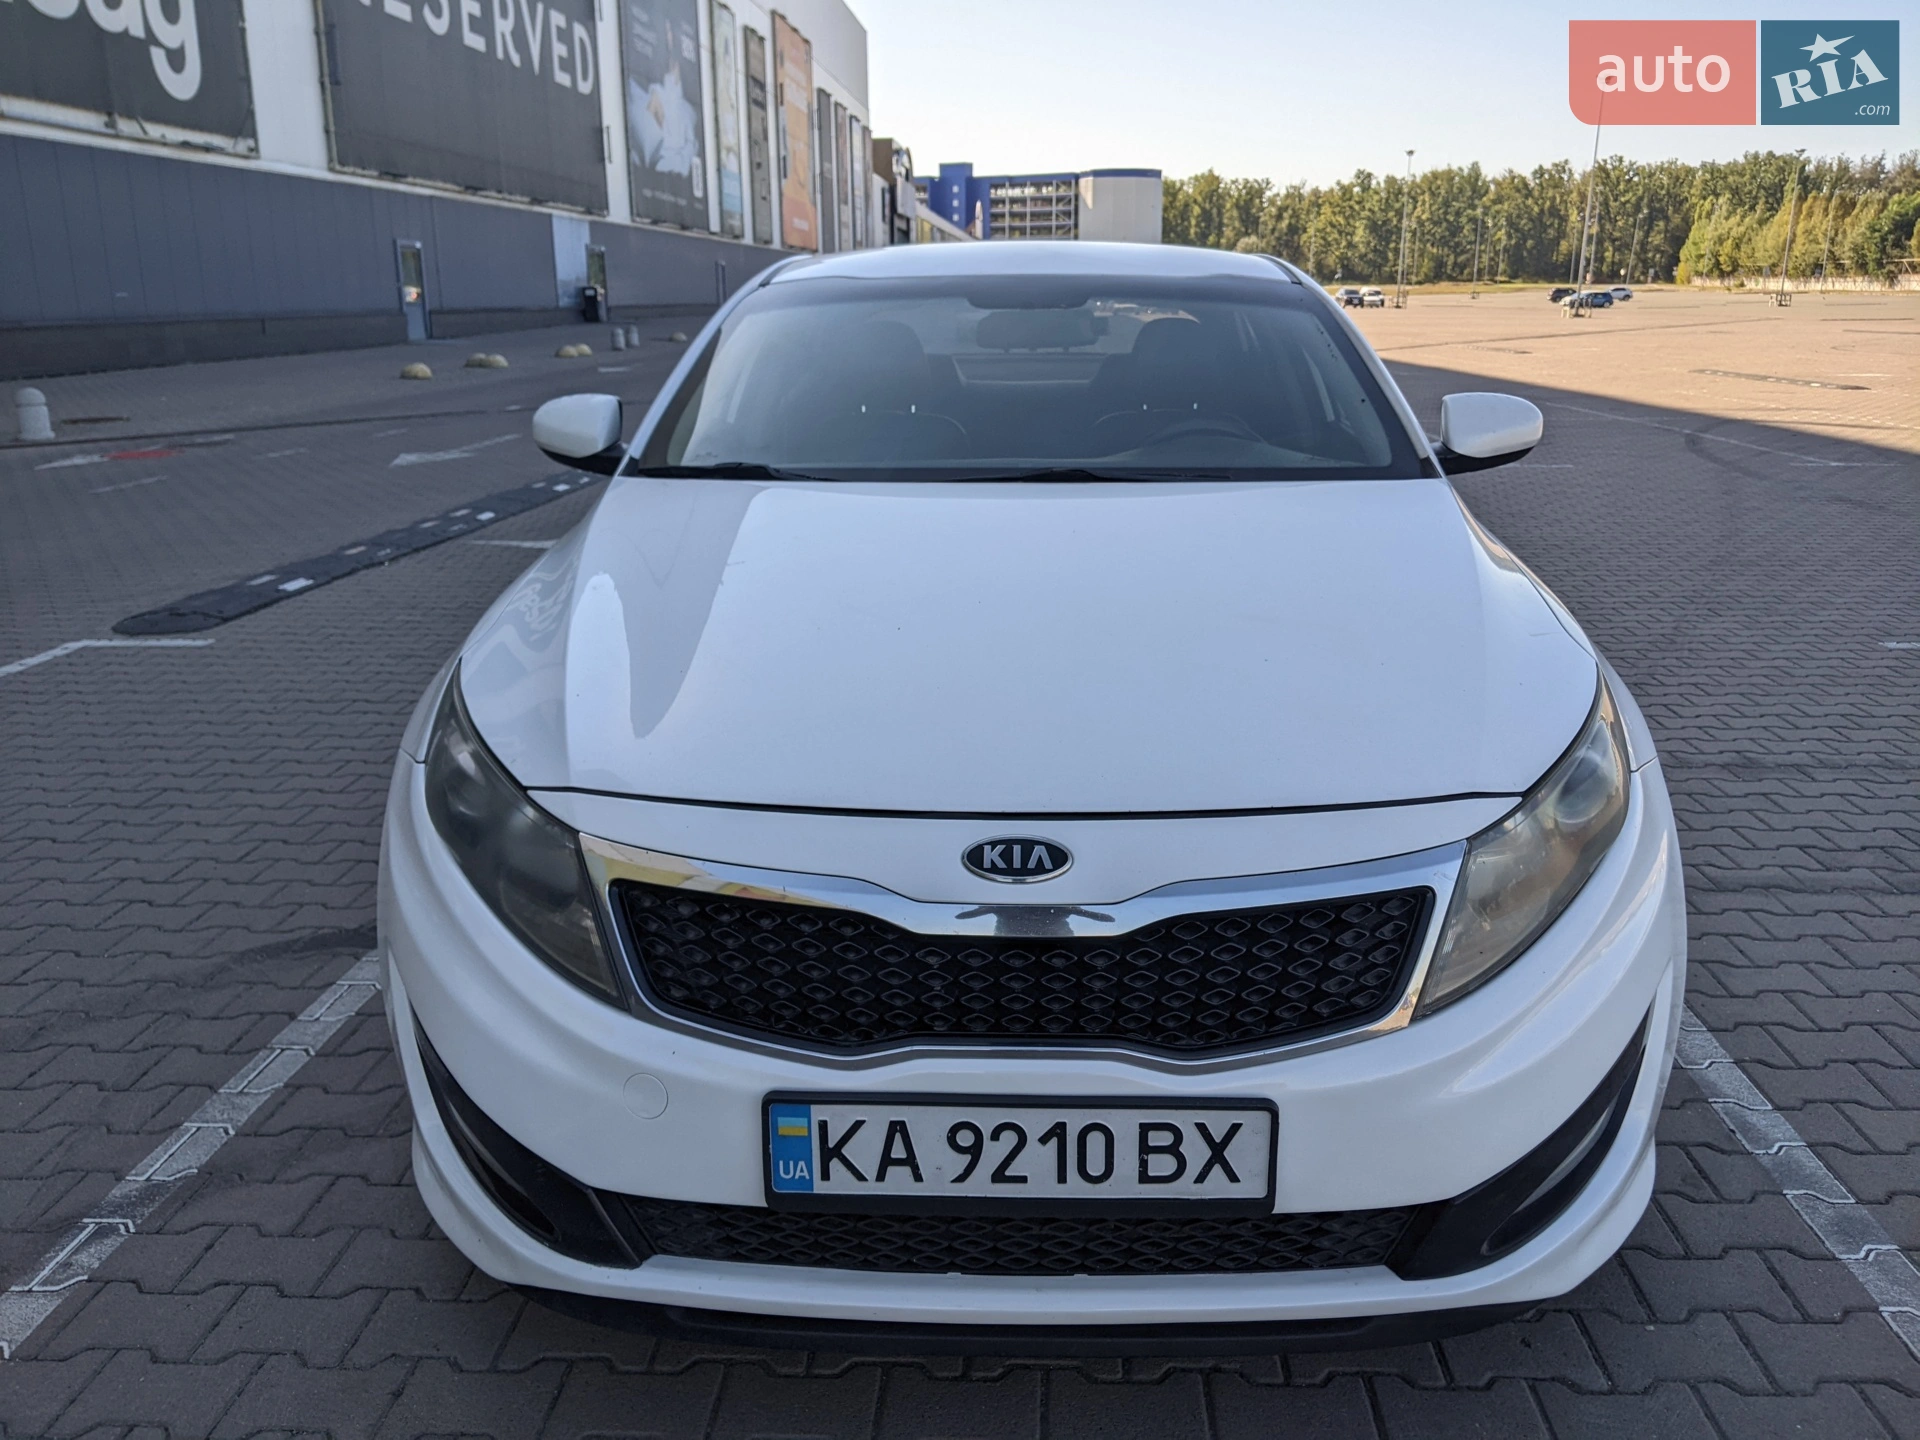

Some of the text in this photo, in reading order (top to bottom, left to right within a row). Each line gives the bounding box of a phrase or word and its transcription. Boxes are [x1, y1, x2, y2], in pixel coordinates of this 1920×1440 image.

[358, 0, 594, 96] ERVED
[982, 844, 1054, 870] KIA
[779, 1159, 810, 1180] UA
[818, 1120, 1244, 1185] KA 9210 BX
